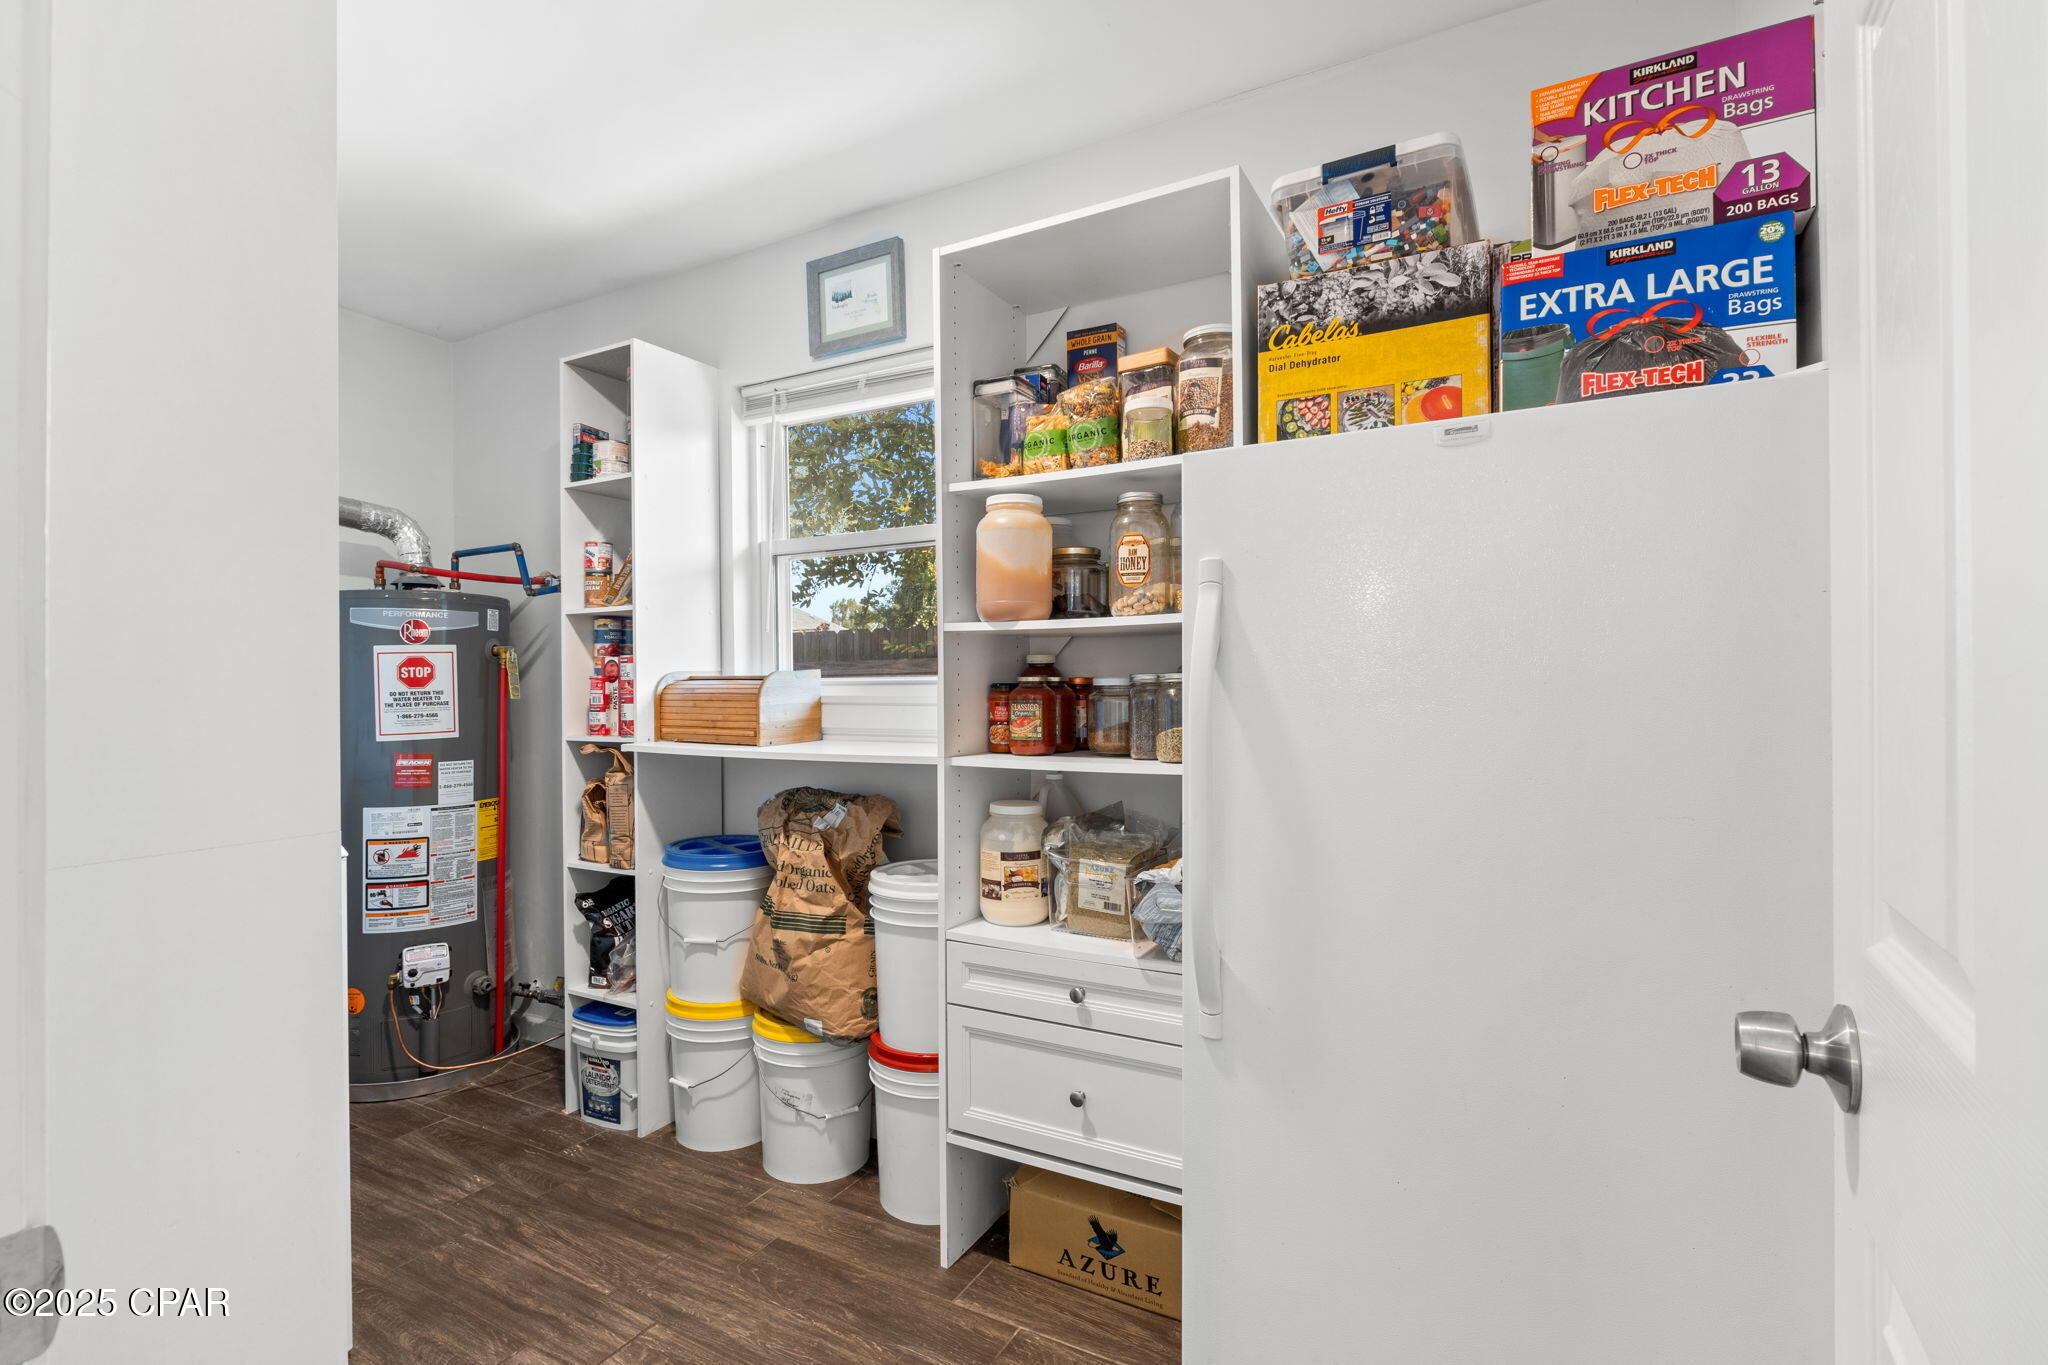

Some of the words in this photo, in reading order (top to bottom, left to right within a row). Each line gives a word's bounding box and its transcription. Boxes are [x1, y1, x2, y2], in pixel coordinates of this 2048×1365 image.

[1633, 55, 1695, 78] KIRKLAND
[1584, 61, 1747, 127] KITCHEN
[1721, 84, 1775, 103] DRAWSTRING
[1723, 93, 1774, 119] Bags
[1656, 147, 1678, 157] THICK
[1645, 156, 1659, 165] TOP
[1741, 158, 1781, 187] 13
[1592, 163, 1719, 214] FLEX-TECH
[1742, 180, 1780, 195] GALLON
[1325, 203, 1348, 215] Hefty
[1726, 201, 1753, 217] 200
[1757, 192, 1799, 212] BAGS
[1577, 232, 1589, 240] 60.9
[1603, 226, 1615, 235] 68.5
[1629, 221, 1641, 229] 45.7
[1690, 206, 1710, 217] (BODY)
[1607, 219, 1619, 227] 200
[1619, 216, 1635, 225] BAGS
[1635, 213, 1648, 221] 49.2
[1653, 209, 1664, 219] (13
[1664, 207, 1677, 216] GAL)
[1603, 233, 1611, 241] FT
[1638, 226, 1649, 234] MIL
[1673, 218, 1684, 227] MIL
[1760, 224, 1785, 235] 20%
[1609, 239, 1674, 259] KIRKLAND
[1519, 278, 1635, 321] EXTRA
[1647, 254, 1774, 301] LARGE
[1728, 286, 1779, 300] DRAWSTRING
[1728, 294, 1783, 317] Bags
[1070, 336, 1092, 348] WHOLE
[1092, 333, 1112, 344] GRAIN
[1268, 317, 1360, 351] Cabela's
[1746, 333, 1782, 342] FLEXIBLE
[1746, 338, 1789, 348] STRENGTH
[1083, 348, 1098, 356] PENNE
[1078, 360, 1104, 371] Barilla
[1268, 362, 1287, 373] Dial
[1289, 355, 1341, 369] Dehydrator
[1580, 360, 1705, 398] FLEX-TECH
[1068, 427, 1107, 442] ORGANIC
[1024, 437, 1055, 449] RGANIC
[1128, 548, 1138, 556] RAW
[1119, 556, 1147, 571] HONEY
[382, 610, 449, 619] PERFORMANCE
[403, 620, 429, 641] Rheem
[400, 666, 432, 679] STOP
[1011, 703, 1040, 711] CLASSICO
[806, 879, 836, 894] Oats
[1057, 1248, 1163, 1297] AZURE
[1057, 1269, 1081, 1281] Standard
[1081, 1275, 1087, 1283] of
[1087, 1279, 1109, 1292] Healthy
[1116, 1288, 1144, 1303] Abundant
[1144, 1297, 1163, 1310] Living
